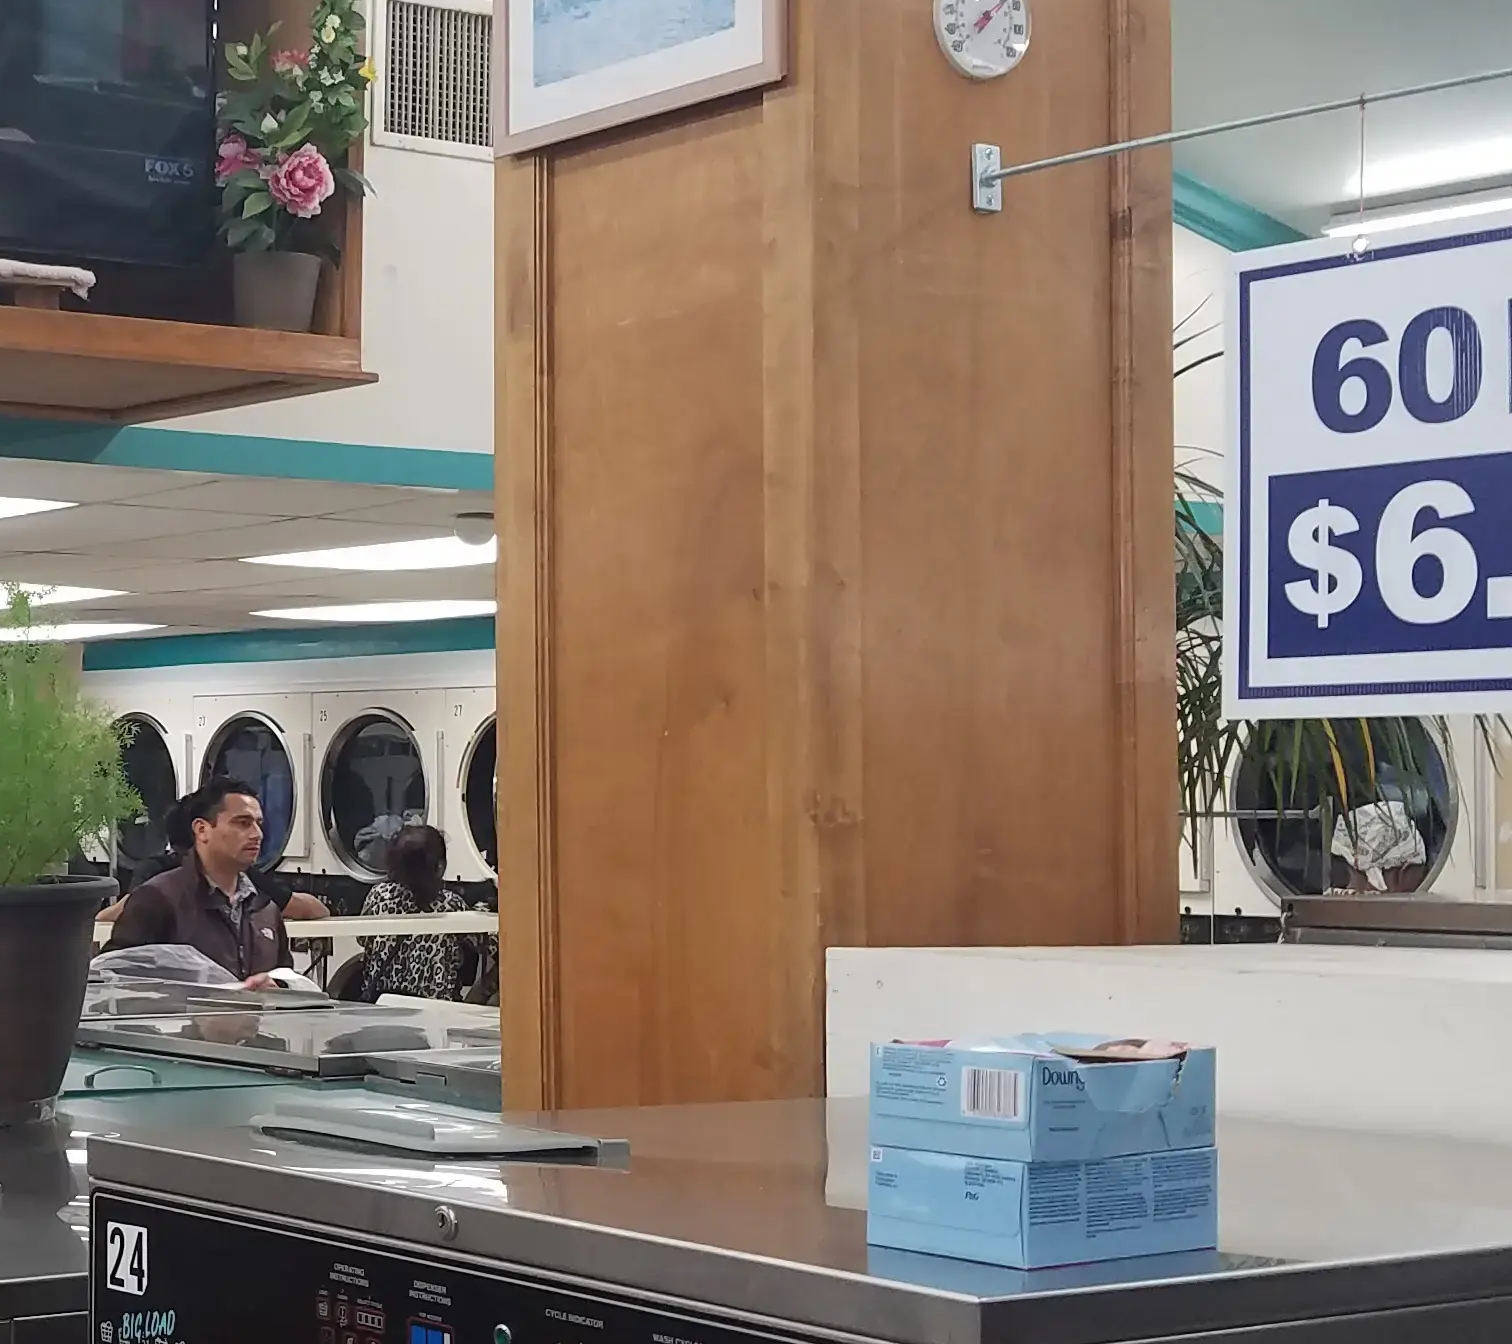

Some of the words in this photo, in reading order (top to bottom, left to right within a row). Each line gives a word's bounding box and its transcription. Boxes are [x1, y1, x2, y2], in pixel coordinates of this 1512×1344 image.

[144, 158, 180, 176] FOX
[1312, 306, 1512, 434] 60
[110, 1226, 145, 1293] 24
[122, 1312, 143, 1343] BIG
[144, 1310, 176, 1339] LOAD
